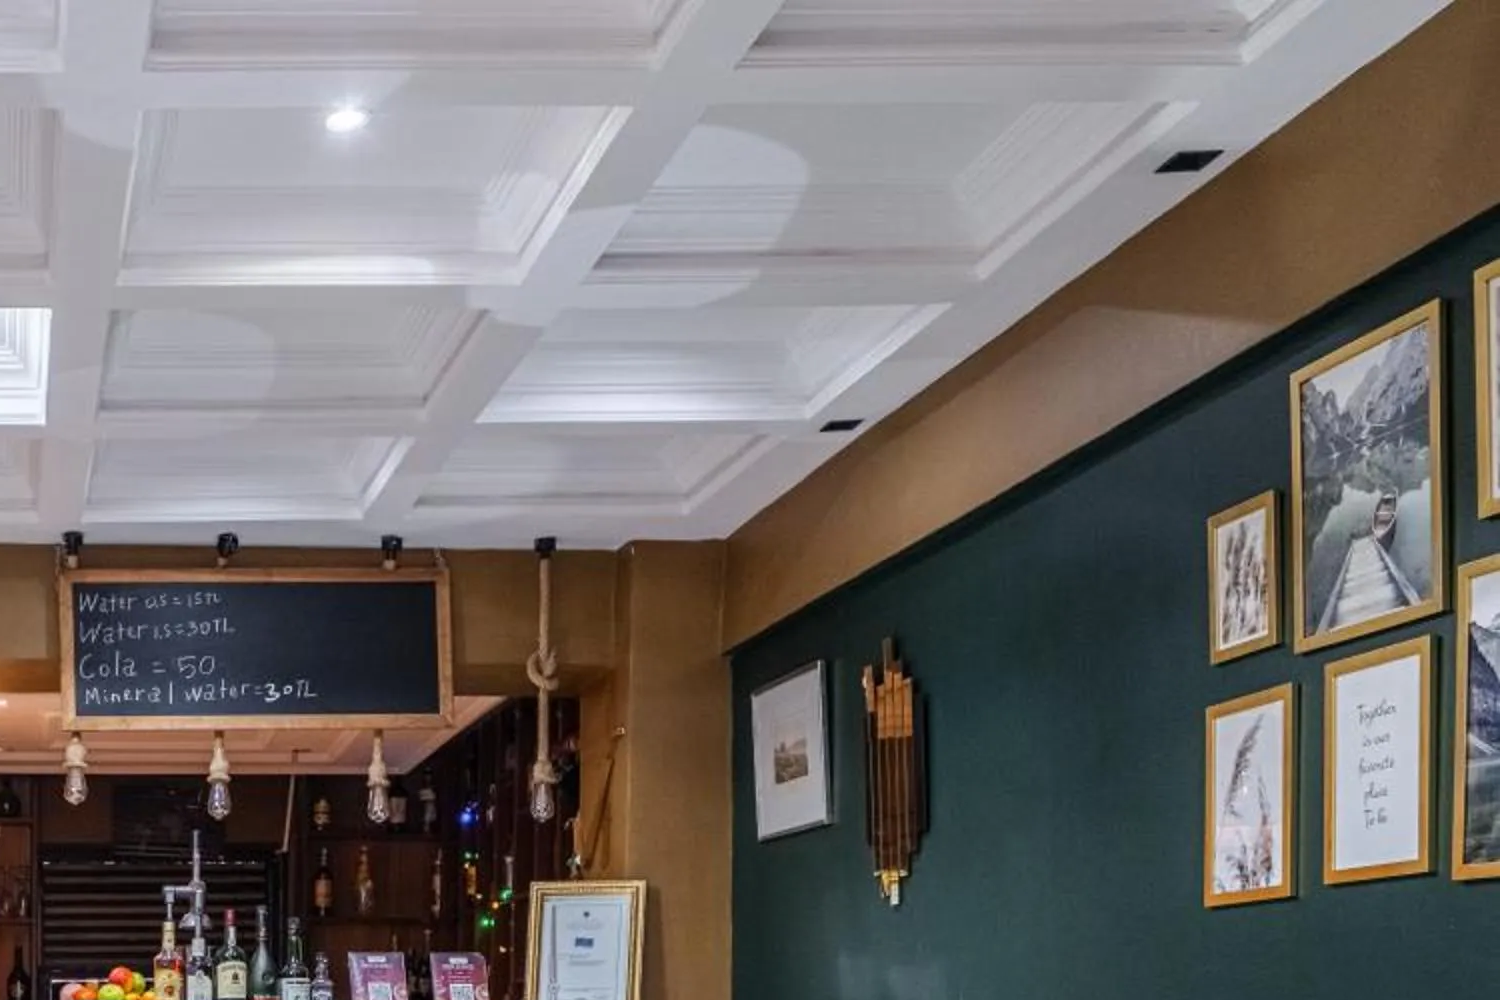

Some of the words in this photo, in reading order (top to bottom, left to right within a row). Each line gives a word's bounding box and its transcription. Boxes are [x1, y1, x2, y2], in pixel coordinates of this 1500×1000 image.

[79, 592, 138, 613] Water
[79, 620, 149, 643] Water
[79, 651, 137, 679] Cola
[177, 655, 216, 679] 50
[85, 681, 174, 704] Mineral
